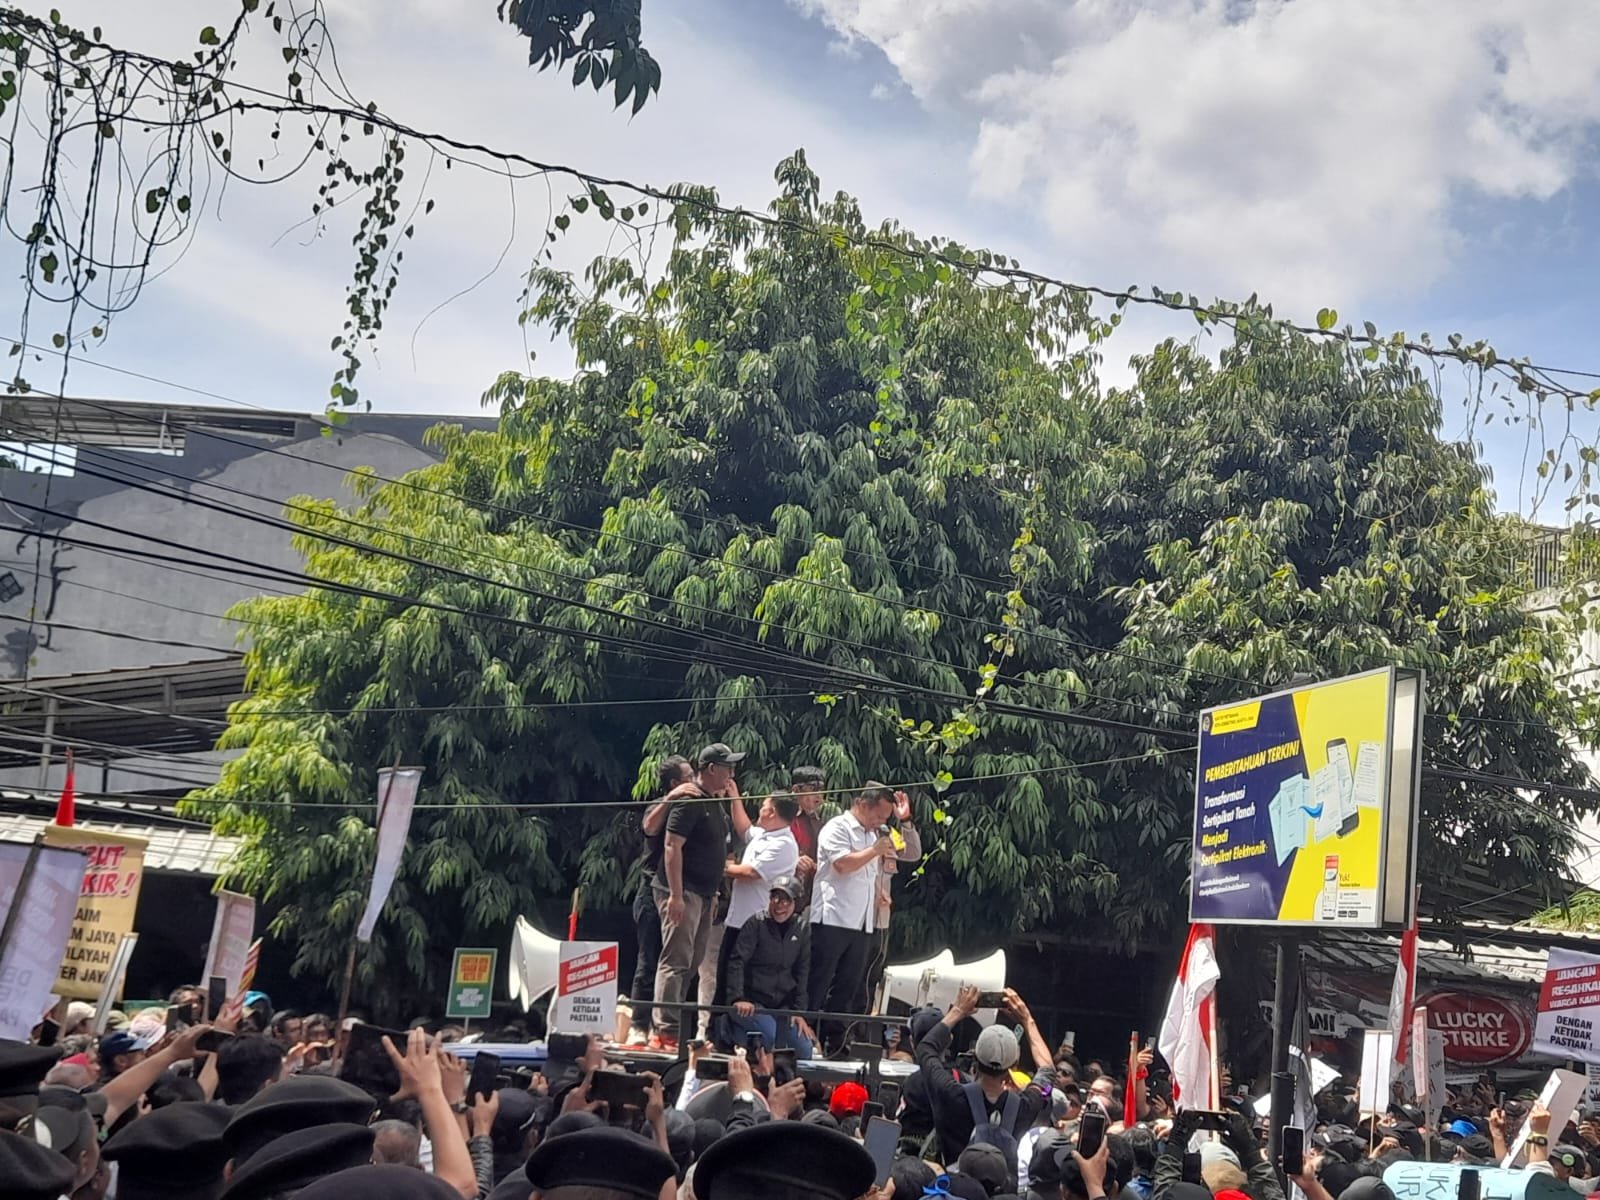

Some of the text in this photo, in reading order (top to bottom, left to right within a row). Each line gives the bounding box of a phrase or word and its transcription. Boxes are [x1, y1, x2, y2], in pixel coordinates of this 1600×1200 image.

[1205, 740, 1300, 783] PEMBERITAHUAN TERKINI
[1204, 785, 1246, 809] Transformasi
[1203, 802, 1256, 829] Sertipikat Tanah
[1202, 829, 1229, 848] Menjadi
[1201, 840, 1264, 867] Sertipikat Elektronik
[81, 873, 118, 895] KIR
[73, 907, 101, 922] AIM
[86, 929, 116, 945] JAYA
[65, 946, 111, 964] ILAYAH
[1555, 966, 1596, 980] JANGAN
[573, 996, 601, 1004] DENGAN
[1549, 997, 1577, 1009] WARGA
[570, 1014, 598, 1022] PASTIAN
[573, 1006, 601, 1014] KETIDAK
[1434, 1011, 1505, 1029] LUCKY
[1556, 1015, 1592, 1030] DENGAN
[1442, 1030, 1511, 1048] STRIKE
[1554, 1026, 1592, 1040] KETIDAK
[1550, 1035, 1586, 1050] PASTIAN
